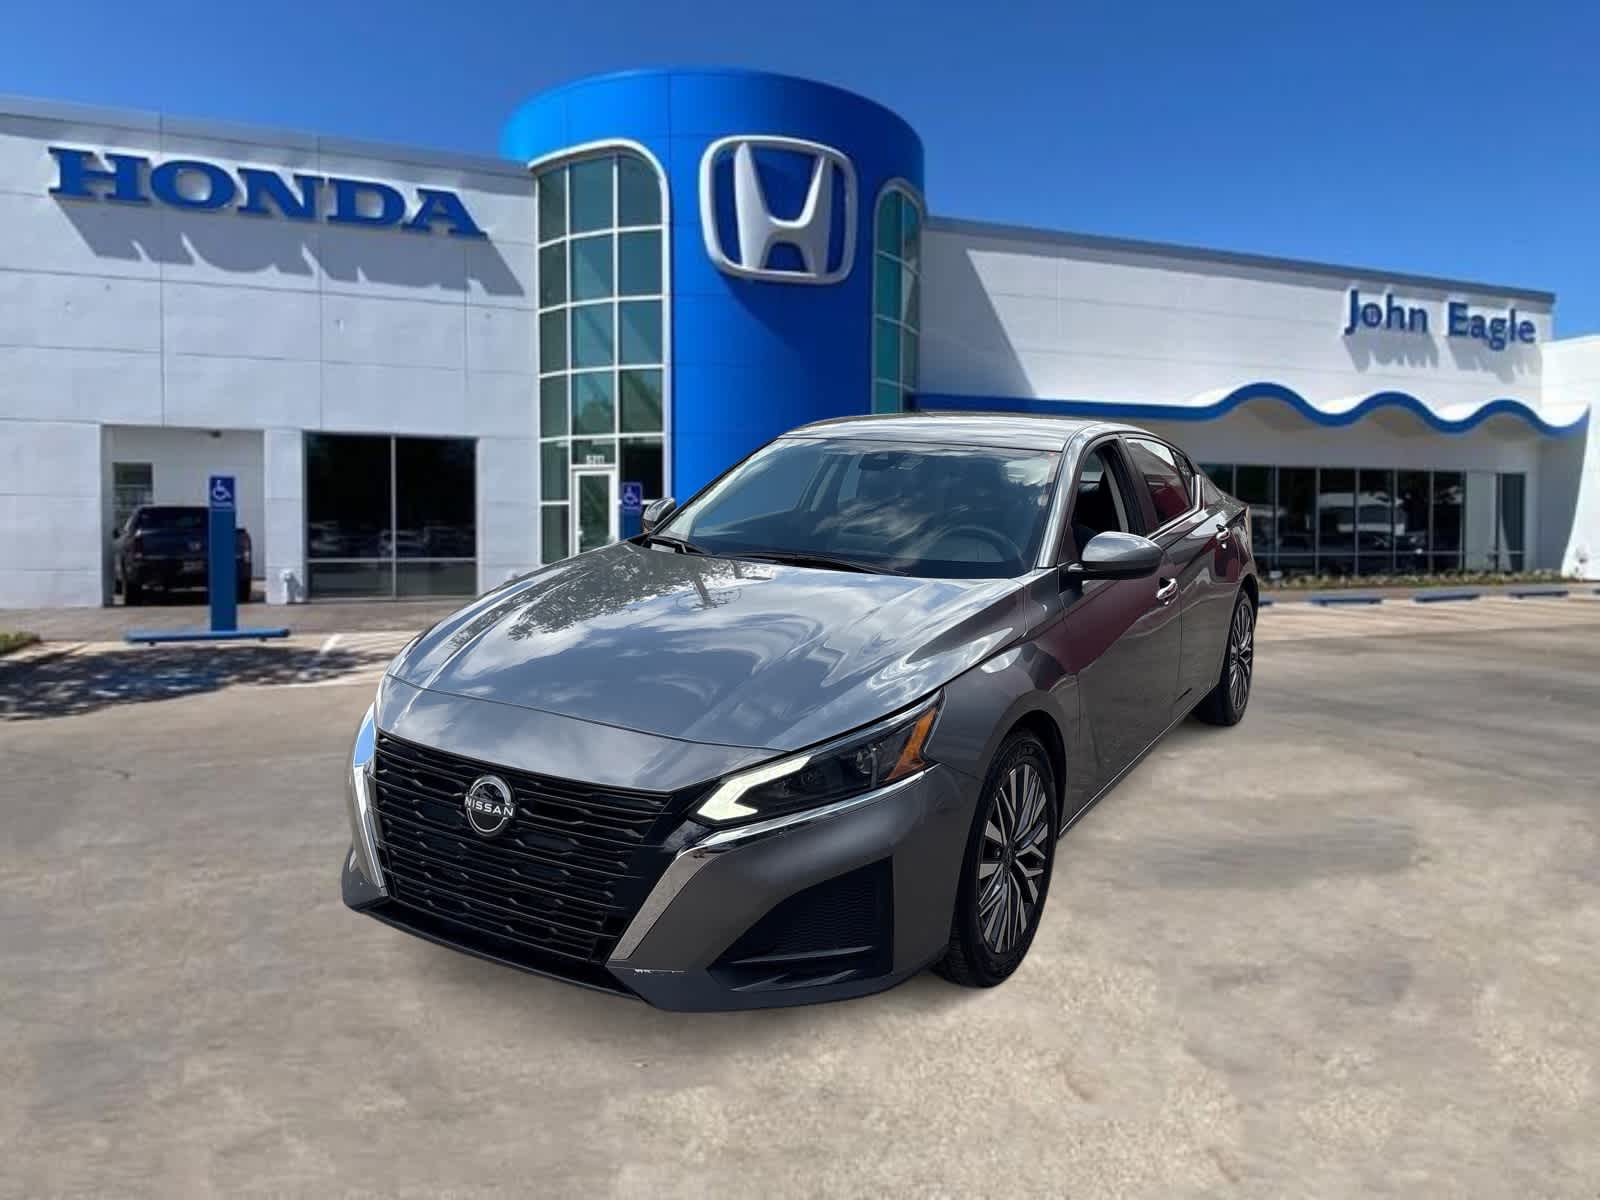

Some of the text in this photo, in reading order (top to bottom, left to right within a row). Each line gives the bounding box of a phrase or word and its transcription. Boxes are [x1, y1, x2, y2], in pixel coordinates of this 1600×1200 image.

[48, 145, 488, 239] HONDA
[1344, 289, 1536, 351] John Eagle
[464, 795, 514, 817] NISSAN
